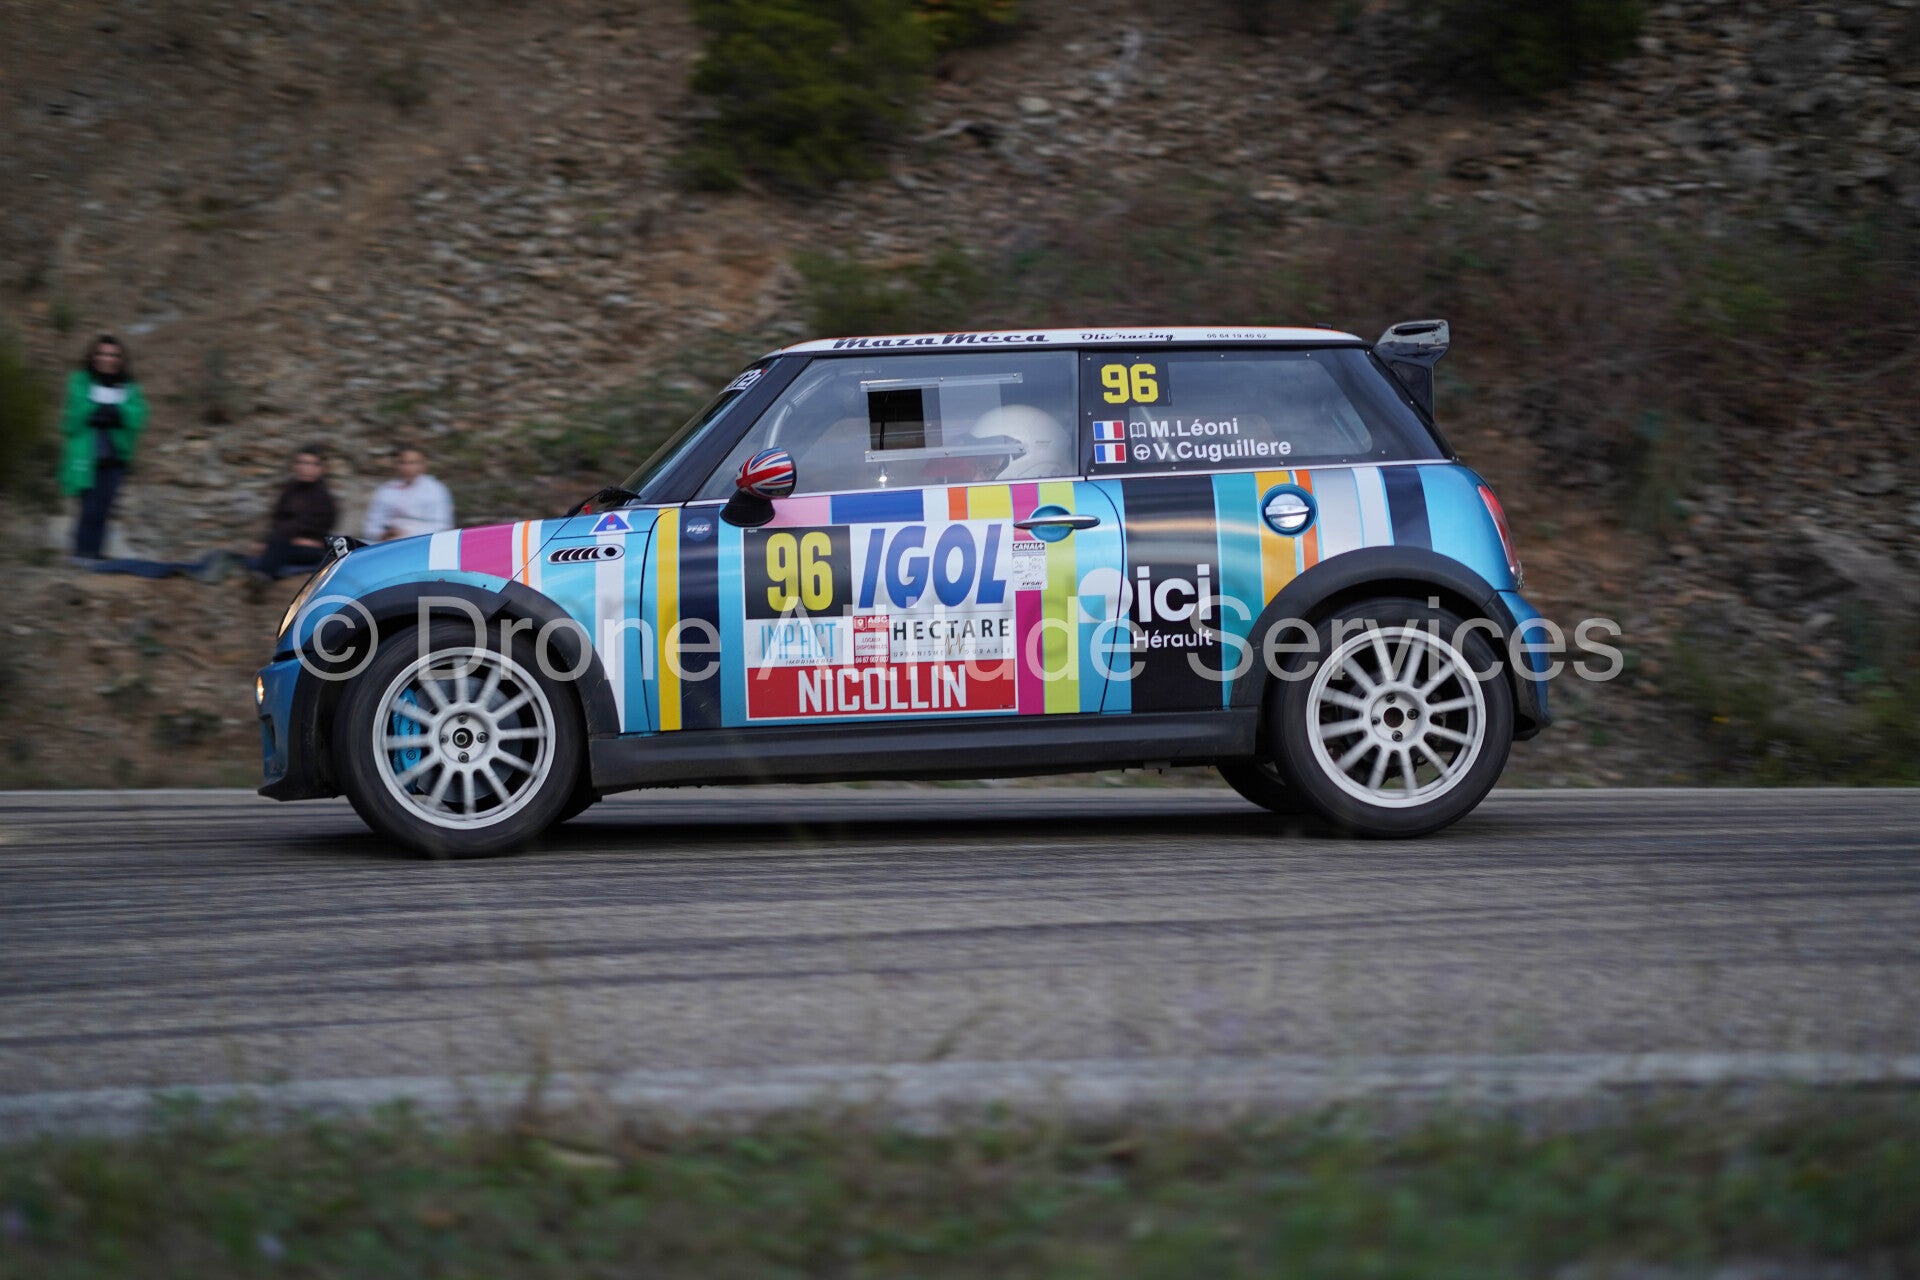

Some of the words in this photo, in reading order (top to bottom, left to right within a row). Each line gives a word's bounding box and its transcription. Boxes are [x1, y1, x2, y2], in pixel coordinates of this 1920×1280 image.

[1101, 363, 1159, 404] 96
[1150, 418, 1239, 438] M.Léoni
[1153, 438, 1291, 462] V.Cuguillere
[1013, 543, 1045, 551] CANAL+
[766, 531, 833, 612] 96
[858, 524, 1007, 609] IGOL
[1137, 564, 1212, 624] ici
[867, 616, 888, 624] ABC
[893, 618, 1010, 640] HECTARE
[1132, 626, 1214, 650] Hérault
[798, 665, 966, 713] NICOLLIN
